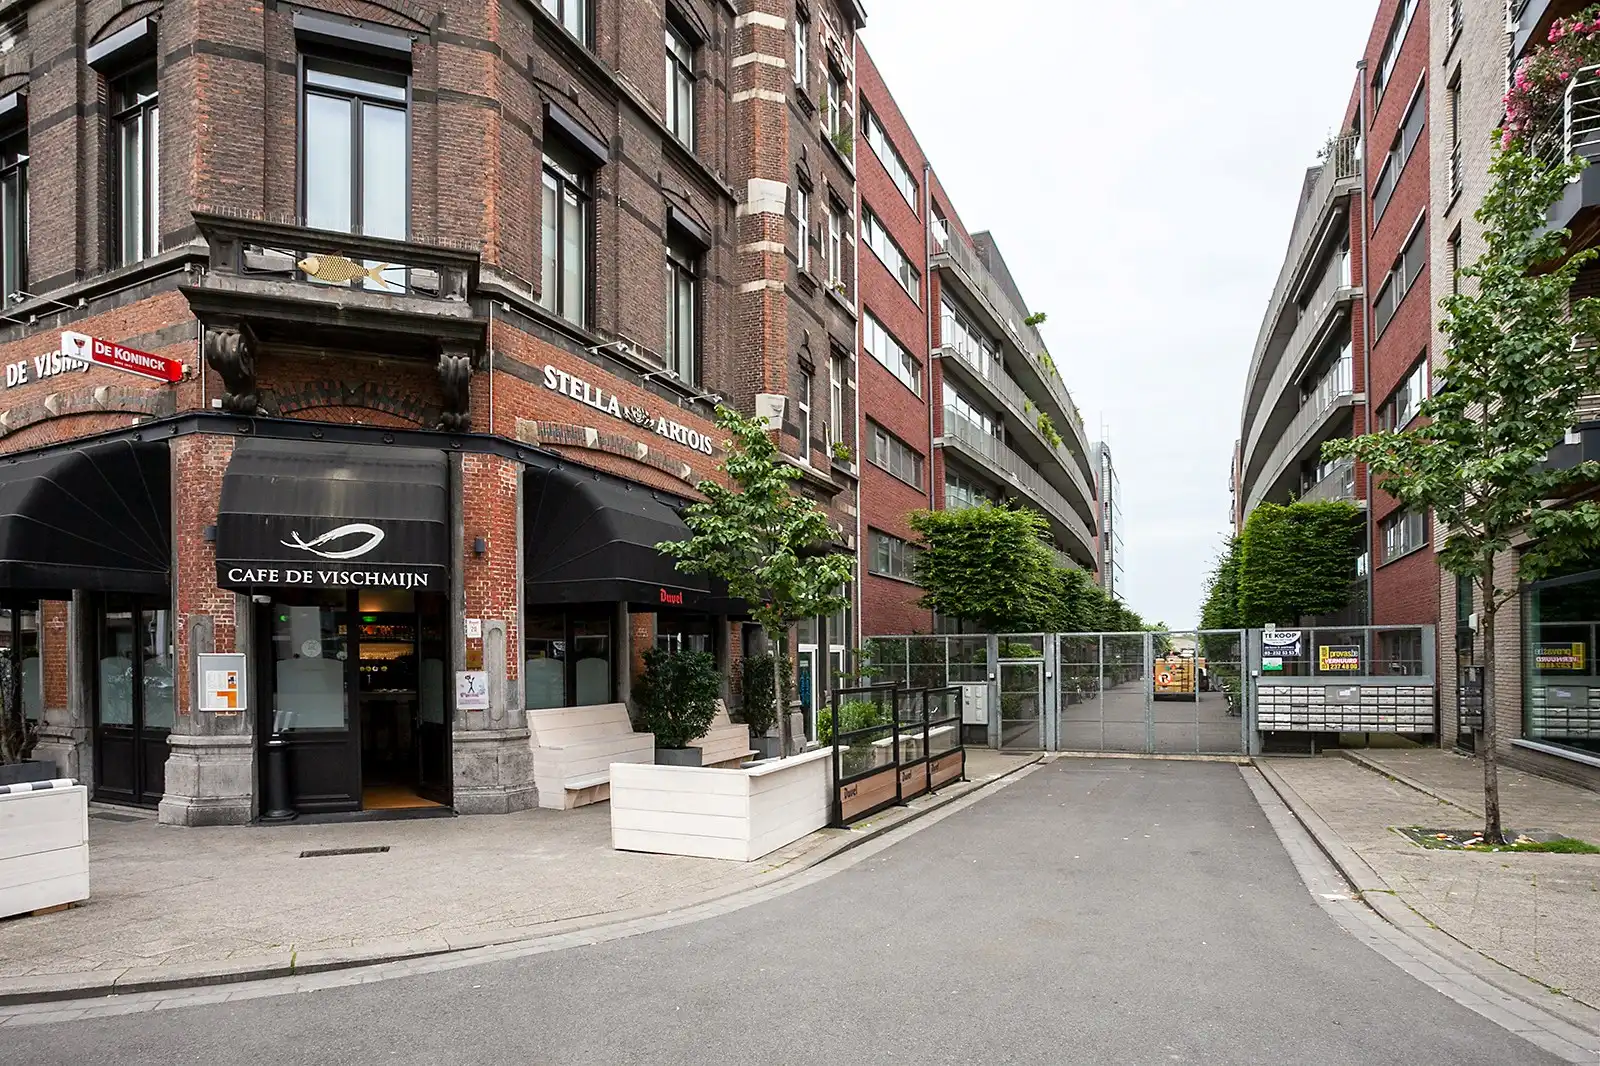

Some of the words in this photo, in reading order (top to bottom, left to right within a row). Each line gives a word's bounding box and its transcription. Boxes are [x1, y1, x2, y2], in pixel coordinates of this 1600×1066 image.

[95, 341, 112, 357] DE
[114, 347, 165, 372] KONINCK
[6, 360, 28, 387] DE
[543, 364, 623, 420] STELLA
[656, 417, 713, 456] ARTOIS
[228, 568, 279, 583] CAFE
[285, 570, 313, 584] DE
[317, 571, 429, 590] VISCHMIJN
[660, 588, 683, 604] Duvel
[844, 783, 858, 799] Duvel
